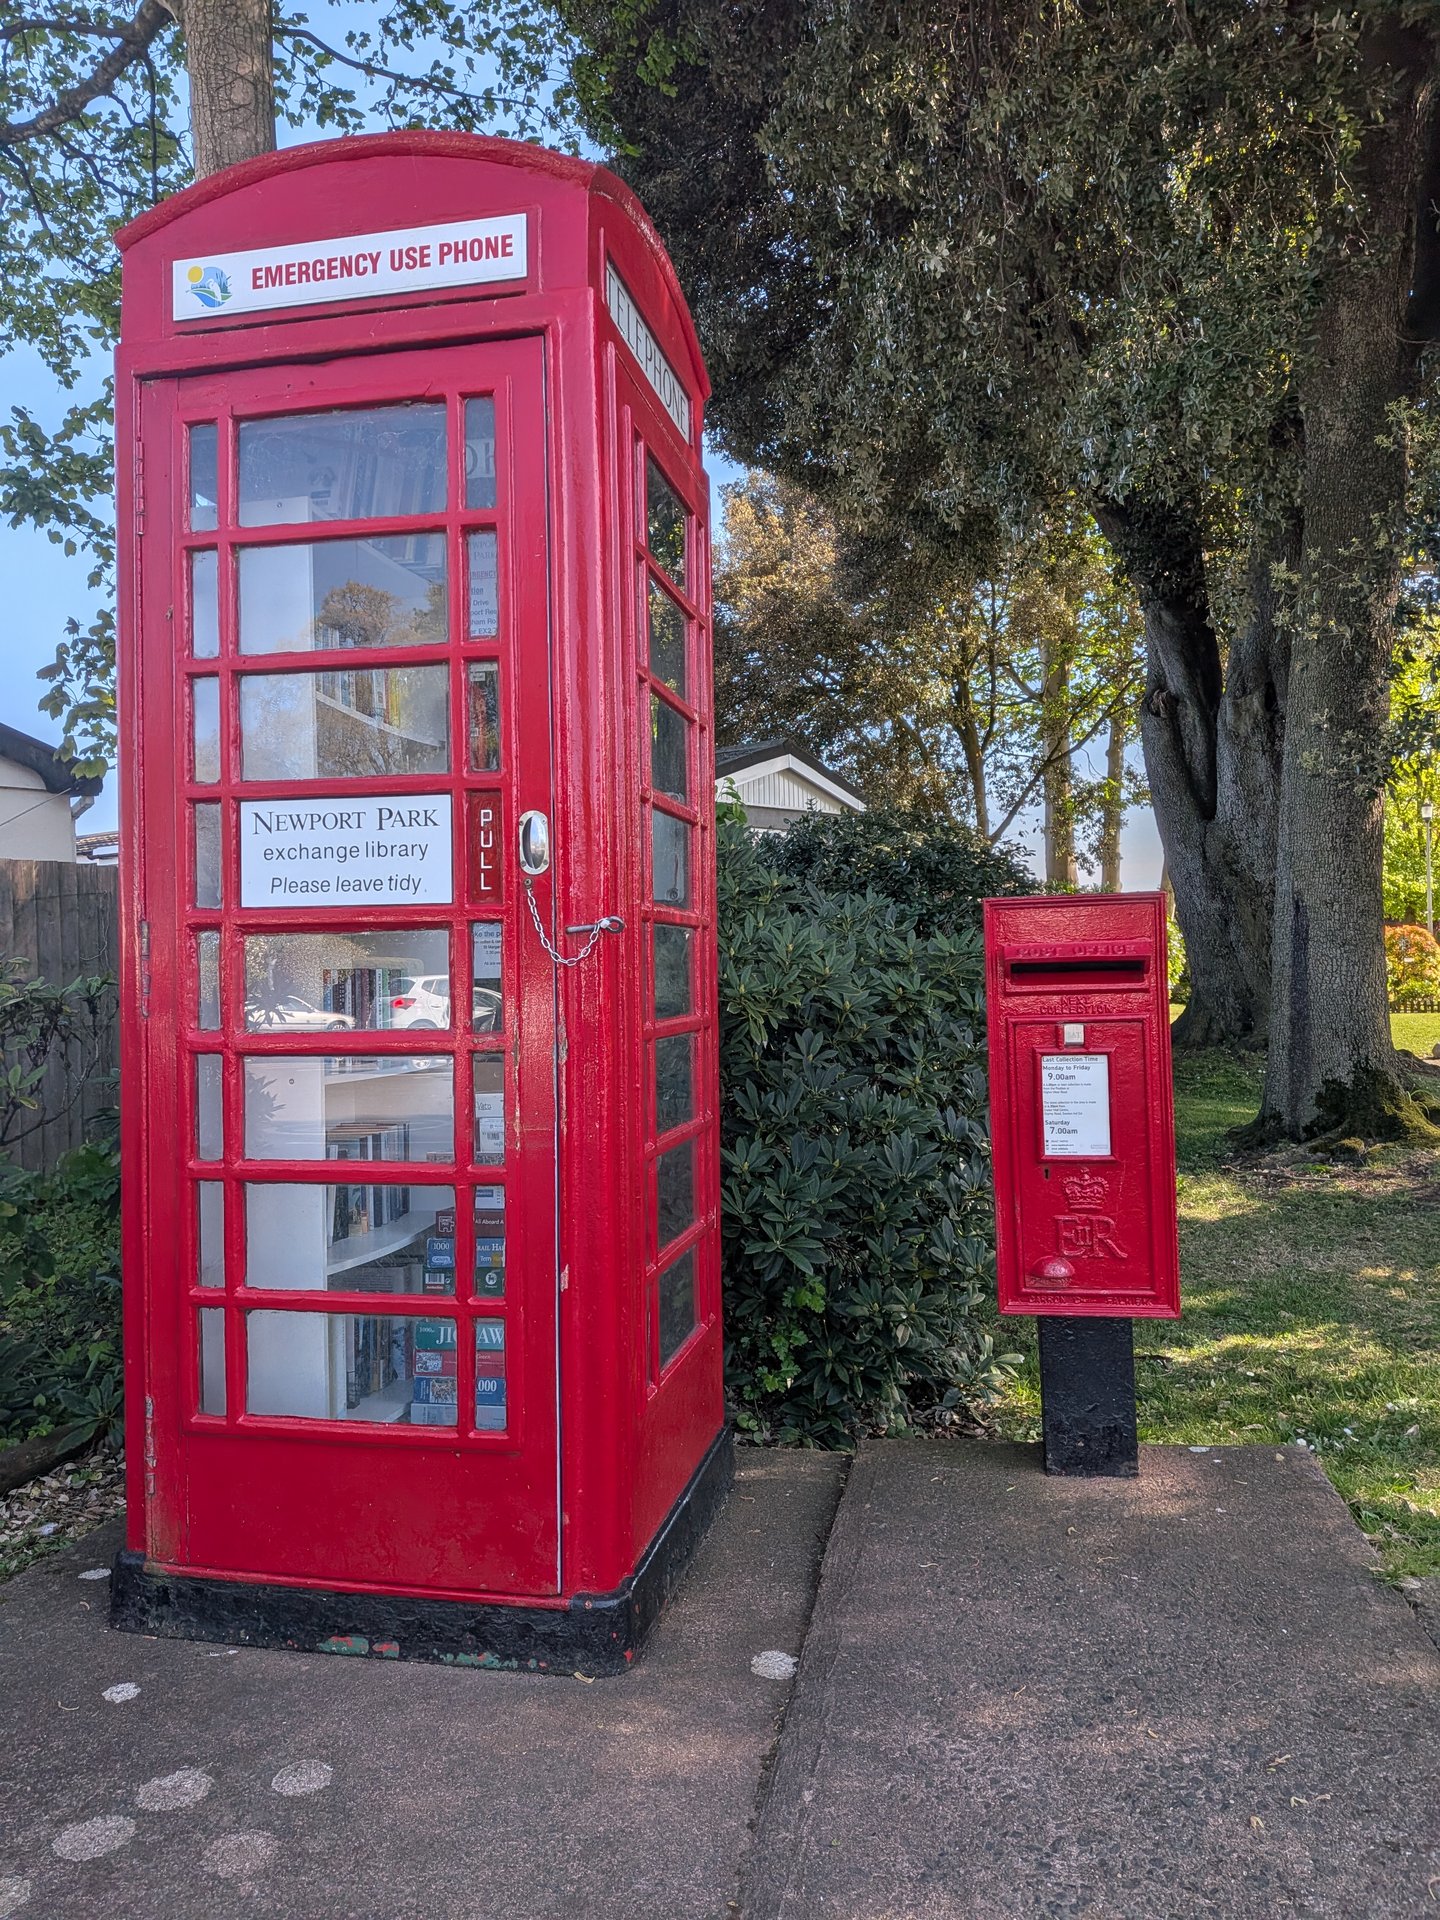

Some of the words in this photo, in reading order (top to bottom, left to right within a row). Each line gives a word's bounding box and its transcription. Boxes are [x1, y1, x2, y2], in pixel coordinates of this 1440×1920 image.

[251, 250, 381, 291] EMERGENCY
[390, 244, 431, 273] USE
[438, 233, 514, 266] PHONE
[607, 268, 688, 438] TELEPHONE
[251, 810, 366, 834] NEWPORT
[376, 807, 440, 831] PARK
[263, 843, 360, 865] exchange
[365, 840, 429, 861] library
[480, 809, 492, 890] PULL
[270, 876, 331, 894] Please
[335, 875, 384, 892] leave
[1016, 947, 1062, 958] POST
[1072, 945, 1136, 956] OFFICE
[1047, 1073, 1076, 1081] 9.00am
[1050, 1126, 1078, 1135] 7.00am
[433, 1242, 450, 1251] 1000
